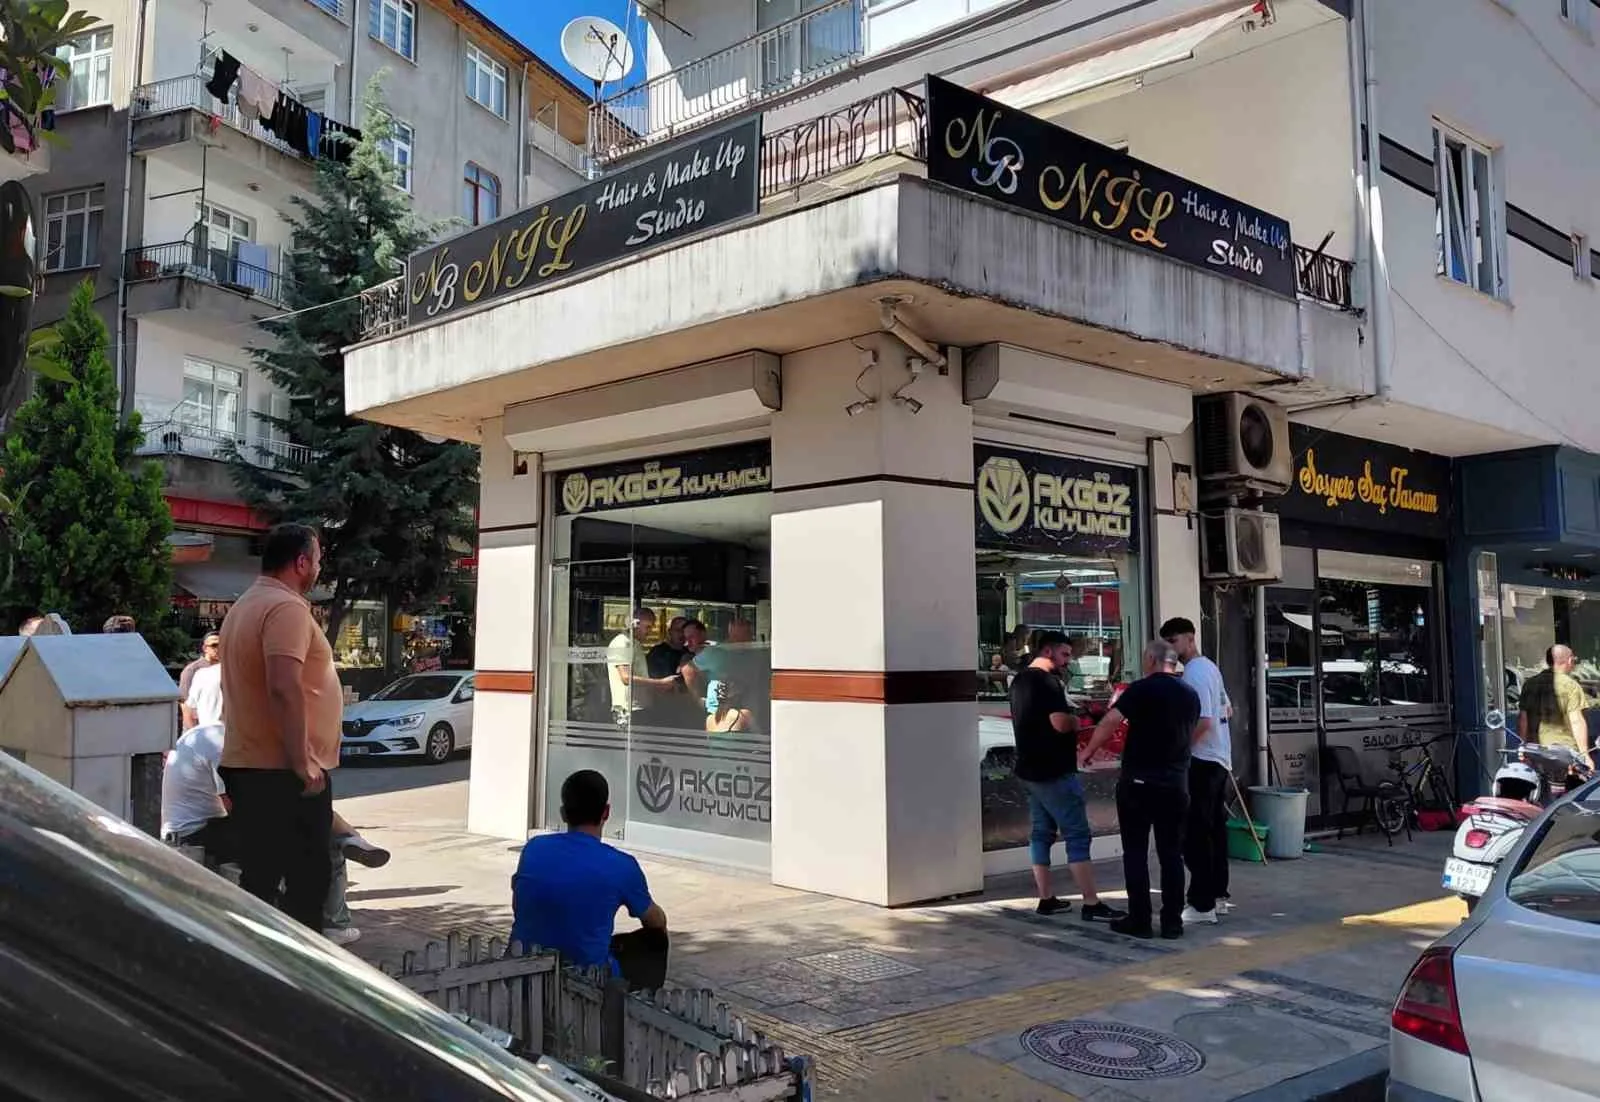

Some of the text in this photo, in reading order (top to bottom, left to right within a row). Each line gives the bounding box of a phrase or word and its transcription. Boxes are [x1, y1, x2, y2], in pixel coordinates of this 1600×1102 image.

[597, 137, 746, 213] Hair & Make Up
[625, 199, 706, 247] Studio
[1038, 162, 1175, 249] NİL
[1181, 189, 1290, 261] Hair & Make Up
[463, 206, 588, 301] NİL
[1206, 239, 1264, 276] Studio
[588, 461, 771, 508] AKGÖZ KUYUMCU
[1033, 471, 1131, 515] AKGÖZ
[1357, 459, 1388, 515] Saç
[1034, 505, 1131, 539] KUYUMCU
[1363, 734, 1399, 747] SALON
[679, 765, 771, 802] AKGÖZ
[679, 796, 771, 822] KUYUMCU
